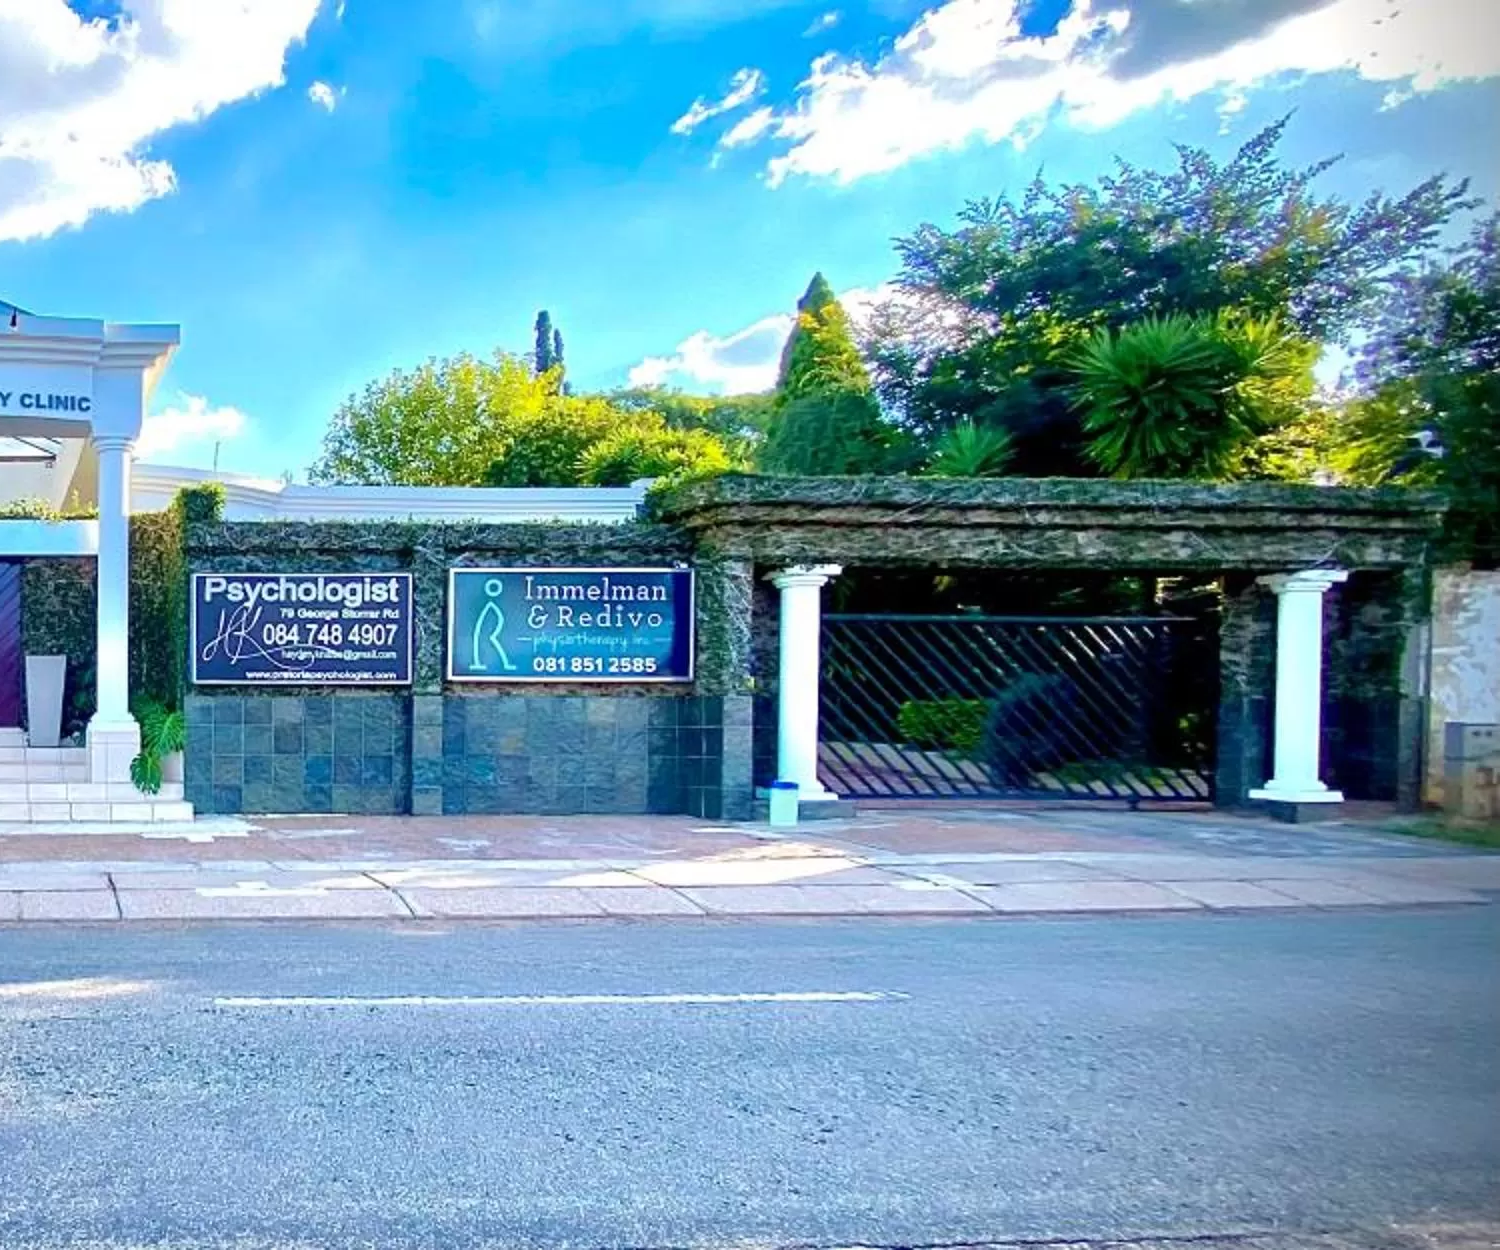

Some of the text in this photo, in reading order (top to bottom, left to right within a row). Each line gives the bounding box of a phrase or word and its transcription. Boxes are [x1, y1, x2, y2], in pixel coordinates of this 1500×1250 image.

[20, 394, 91, 412] CLINIC
[205, 578, 399, 607] Psychologist
[525, 576, 667, 601] Immelman
[280, 608, 294, 618] 79
[298, 608, 338, 620] George
[383, 609, 400, 618] Rd
[528, 604, 663, 628] & Redivo
[263, 624, 398, 645] 084 748 4907
[533, 658, 657, 672] 081 851 2585
